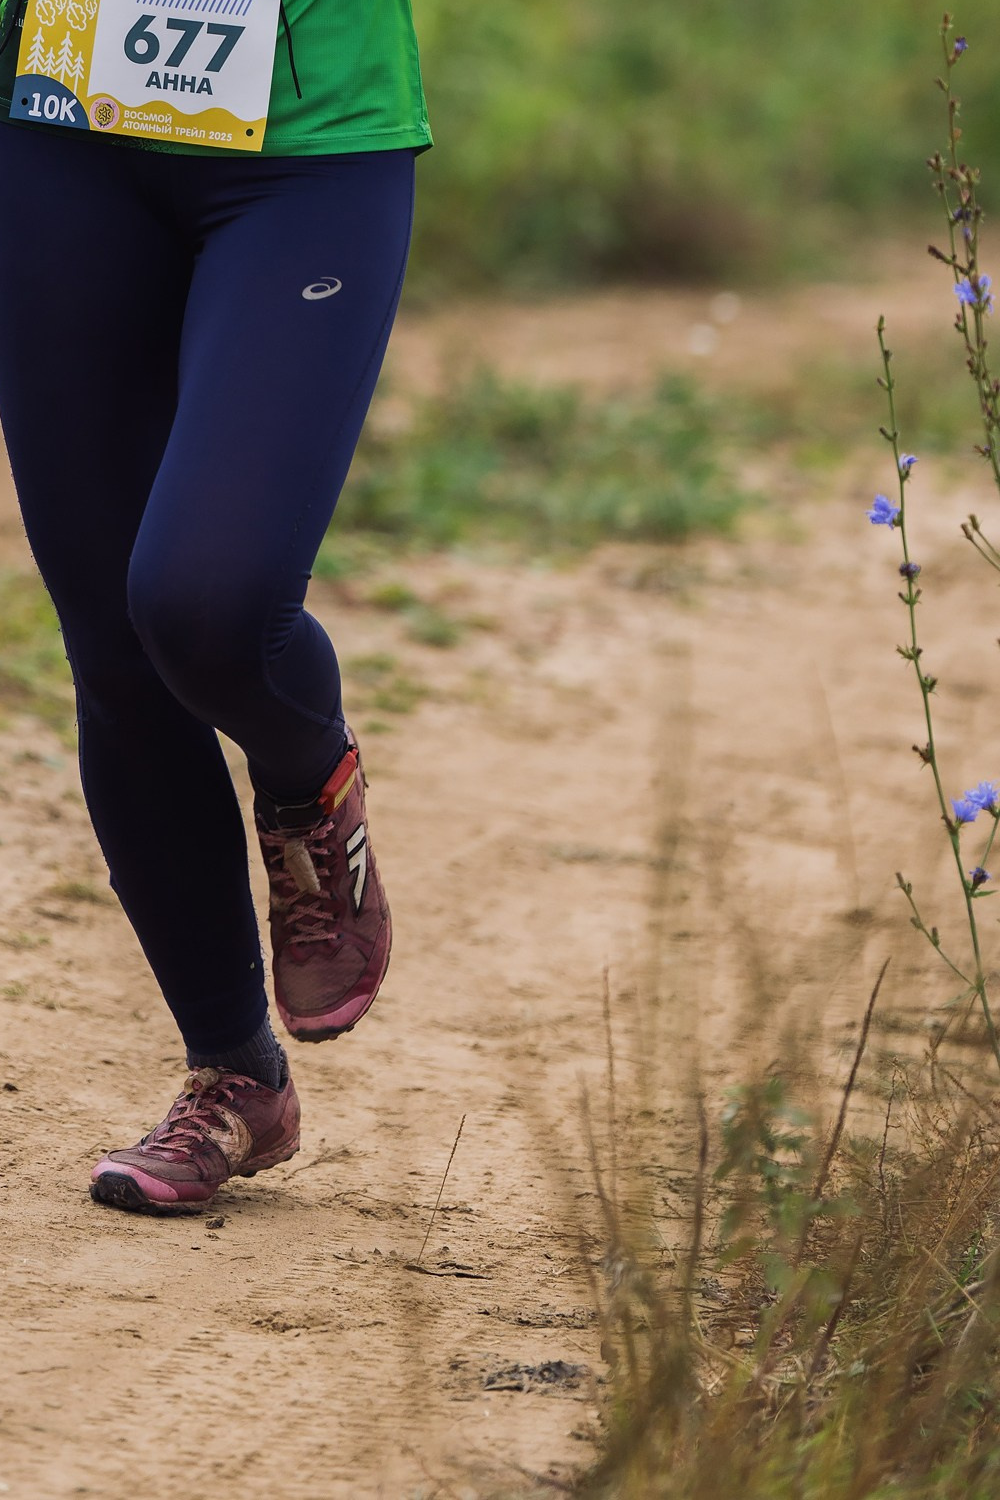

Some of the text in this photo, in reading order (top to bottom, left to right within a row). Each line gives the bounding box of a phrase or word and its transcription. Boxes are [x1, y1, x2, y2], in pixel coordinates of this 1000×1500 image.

[123, 14, 247, 73] 677
[145, 71, 214, 96] АННА
[28, 92, 78, 123] 10K
[123, 110, 173, 125] ВОСЬМОЙ
[122, 120, 233, 142] АТОМНЫЙ ТРЕЙЛ 2025
